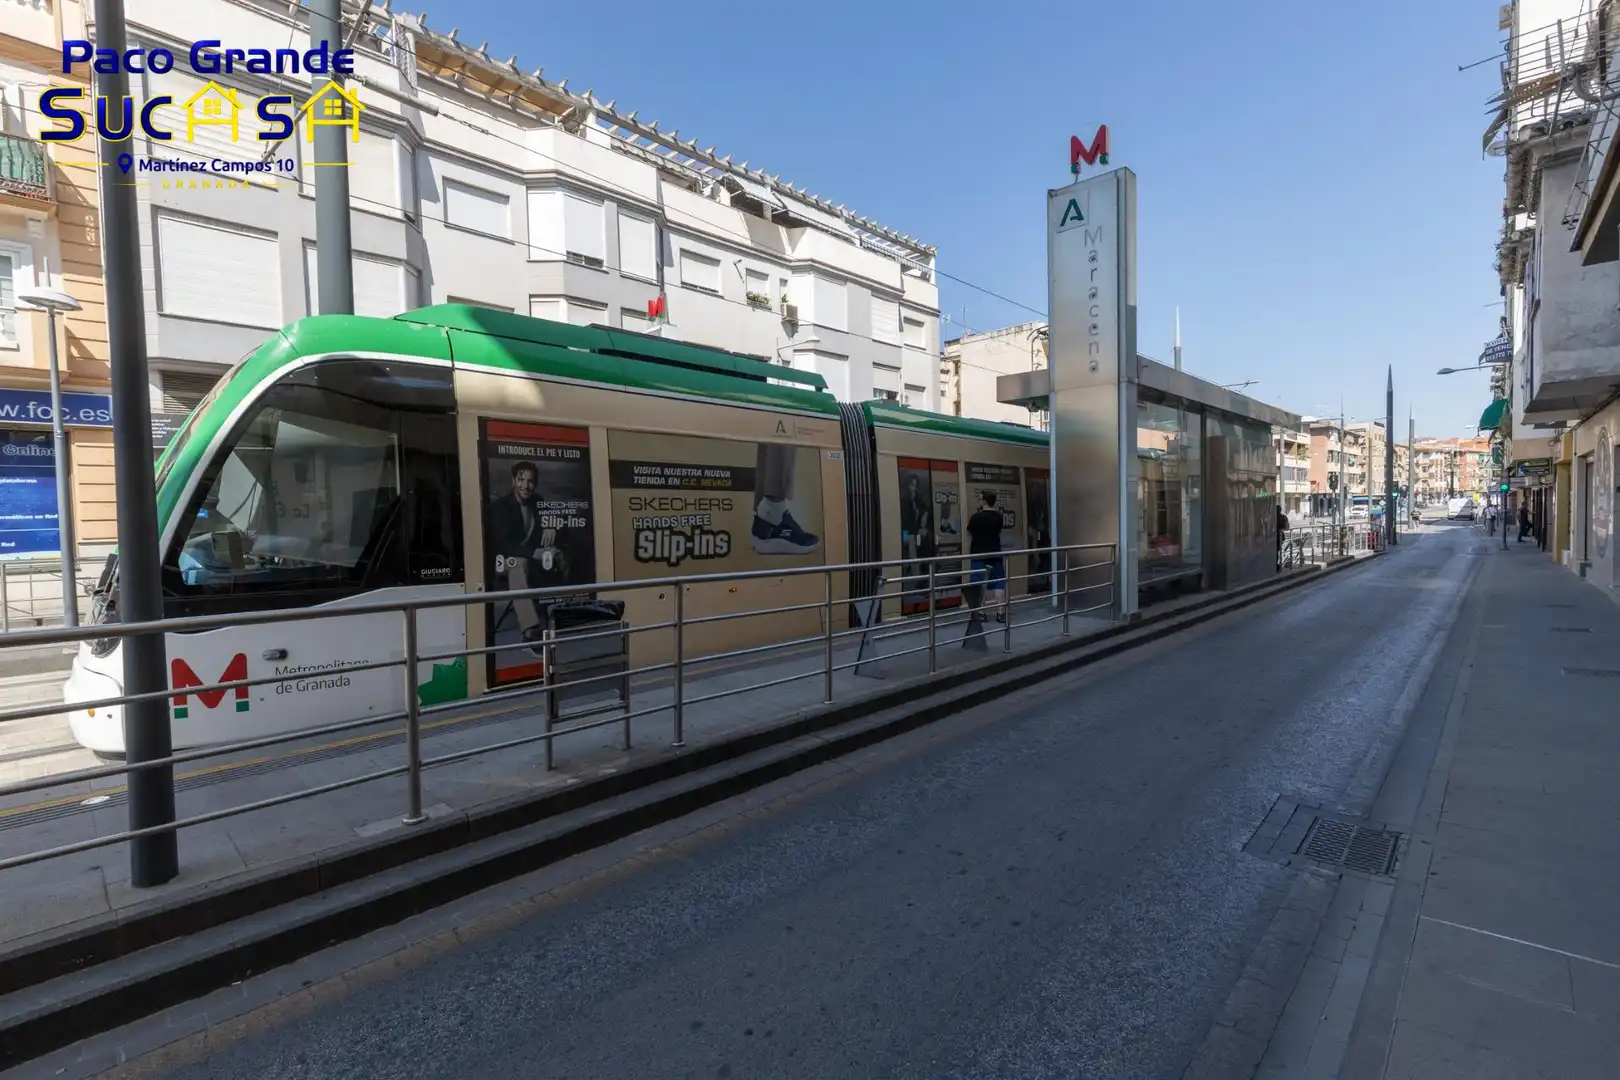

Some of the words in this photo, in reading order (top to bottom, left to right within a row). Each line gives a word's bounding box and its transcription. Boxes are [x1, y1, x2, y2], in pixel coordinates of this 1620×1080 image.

[1084, 225, 1104, 374] Maracena
[498, 445, 536, 457] INTRODUCE
[537, 448, 545, 457] EL
[546, 448, 557, 458] PIE
[558, 449, 563, 457] Y
[563, 449, 580, 459] LISTO
[633, 465, 662, 475] VISITA
[663, 467, 703, 477] NUESTRA
[704, 469, 731, 478] NUEVA
[633, 476, 666, 485] TIENDA
[667, 477, 680, 486] EN
[536, 501, 589, 509] SKECHERS
[628, 496, 734, 512] SKECHERS
[541, 515, 587, 530] Slip-ins
[633, 516, 678, 530] HANDS
[681, 514, 711, 527] FREE
[636, 527, 730, 564] Slip-ins
[275, 680, 293, 695] de
[296, 675, 351, 692] Granada
